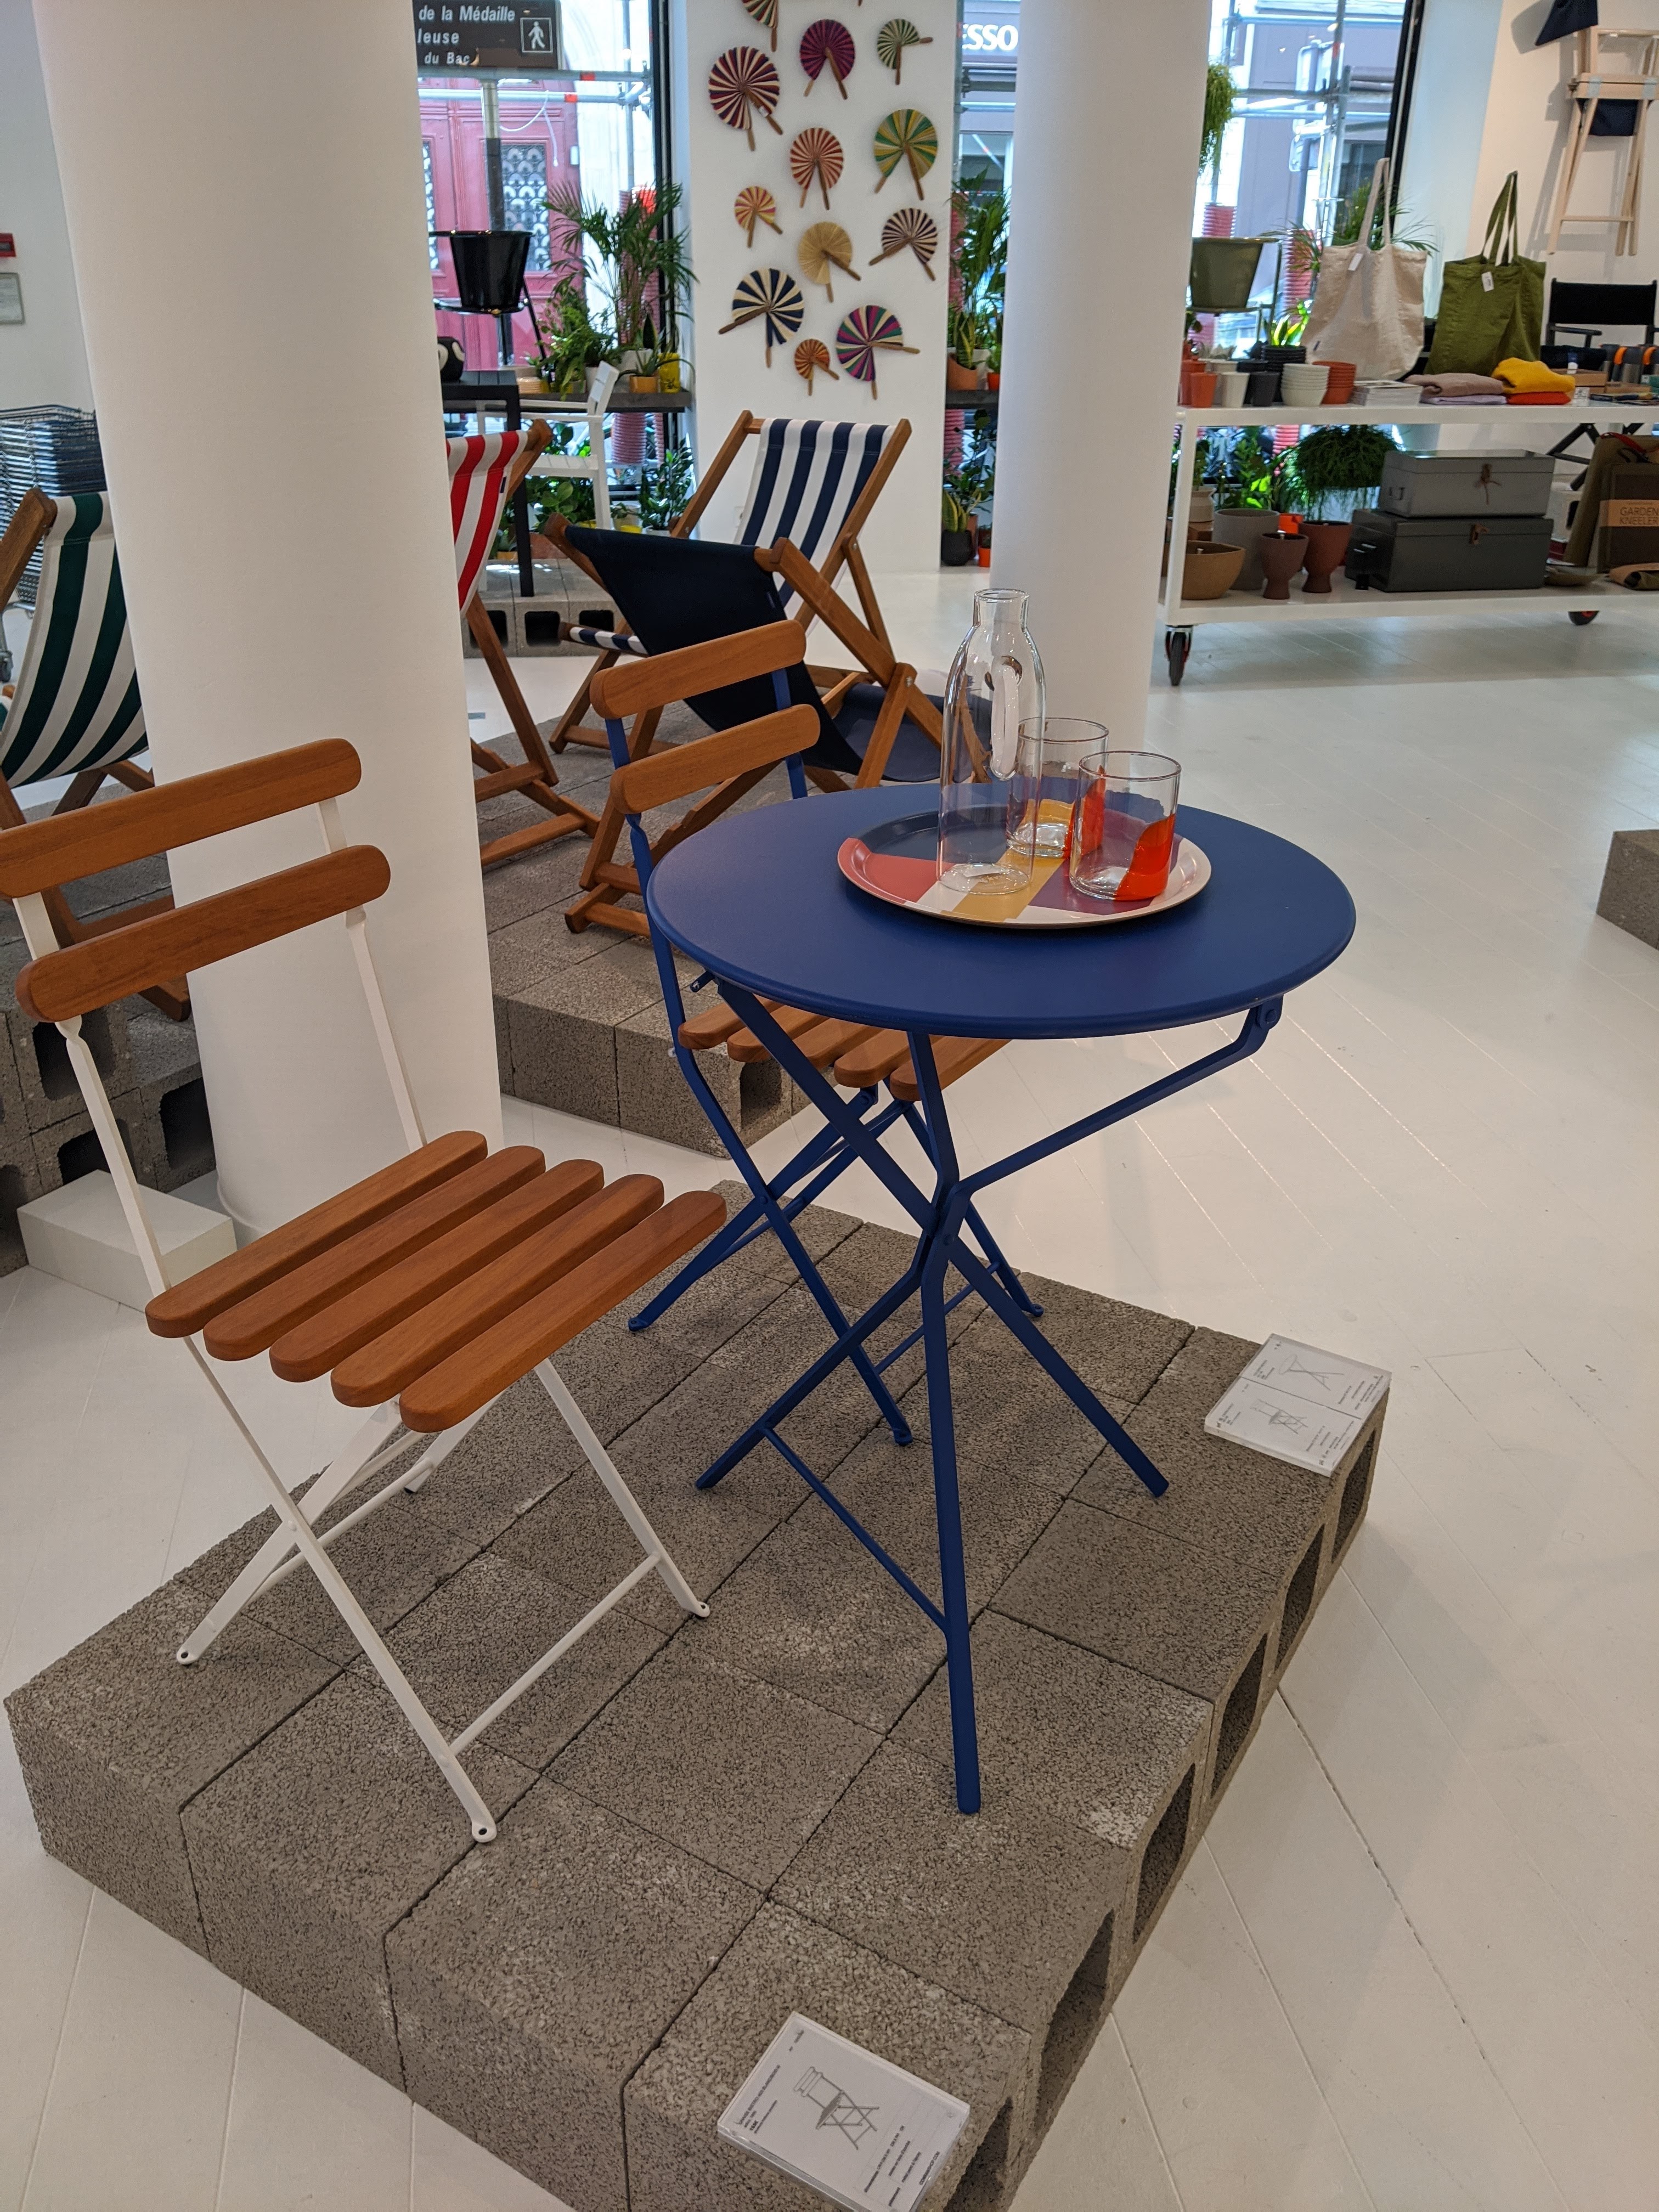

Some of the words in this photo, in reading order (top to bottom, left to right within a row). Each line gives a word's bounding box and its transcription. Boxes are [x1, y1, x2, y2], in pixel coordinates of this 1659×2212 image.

[419, 4, 435, 21] de
[441, 5, 453, 21] la
[459, 5, 516, 22] Médaille
[417, 28, 460, 44] leuse
[424, 52, 439, 64] du
[446, 52, 470, 65] Bac
[1620, 507, 1658, 516] GARDEN
[1620, 516, 1658, 525] KNEELER
